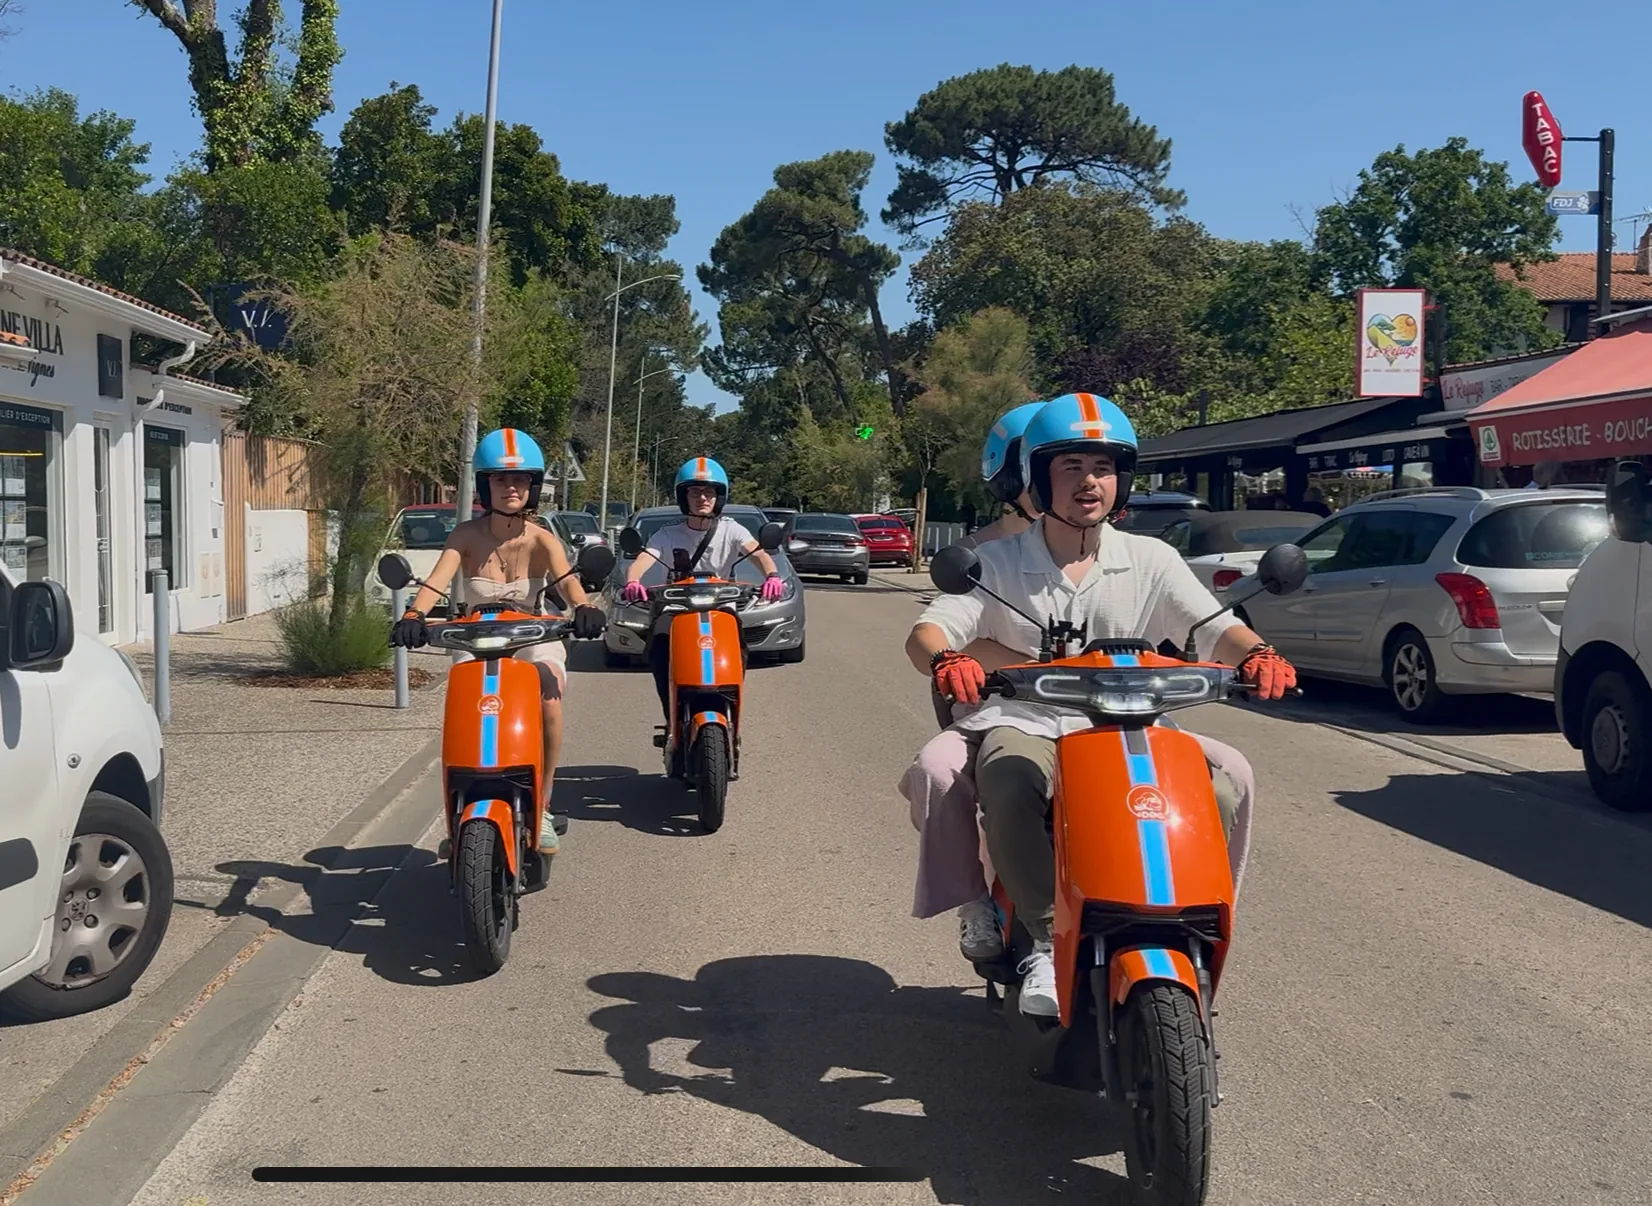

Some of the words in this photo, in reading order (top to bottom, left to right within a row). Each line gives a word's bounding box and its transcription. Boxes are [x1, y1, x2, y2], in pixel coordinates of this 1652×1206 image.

[1532, 103, 1558, 173] TABAC
[1553, 198, 1573, 208] FDJ
[1443, 379, 1454, 400] Le
[15, 410, 51, 425] D'EXCEPTION
[1512, 423, 1591, 451] ROTISSERIE
